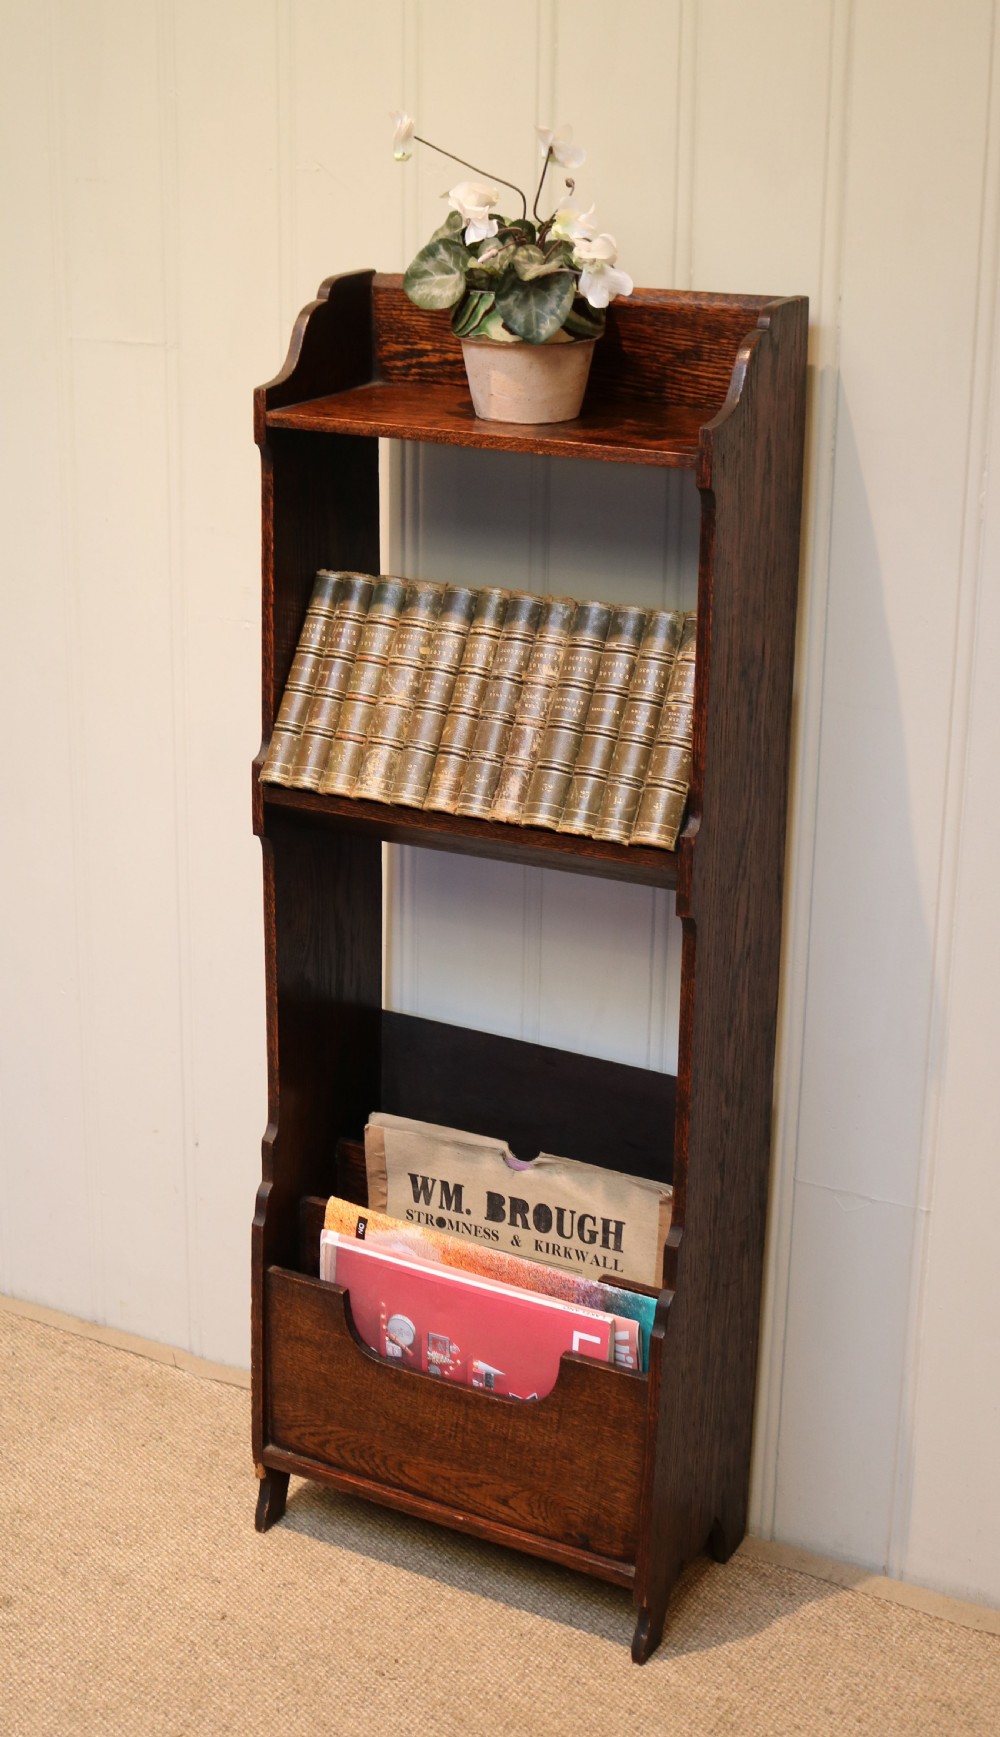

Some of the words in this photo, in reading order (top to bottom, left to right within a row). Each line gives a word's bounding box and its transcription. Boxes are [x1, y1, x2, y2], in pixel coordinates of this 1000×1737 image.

[405, 1208, 500, 1242] STROMNESS
[510, 1234, 523, 1248] &
[534, 1238, 625, 1273] KIRKWALL
[407, 1172, 472, 1216] WM.
[484, 1190, 627, 1254] BROUGH
